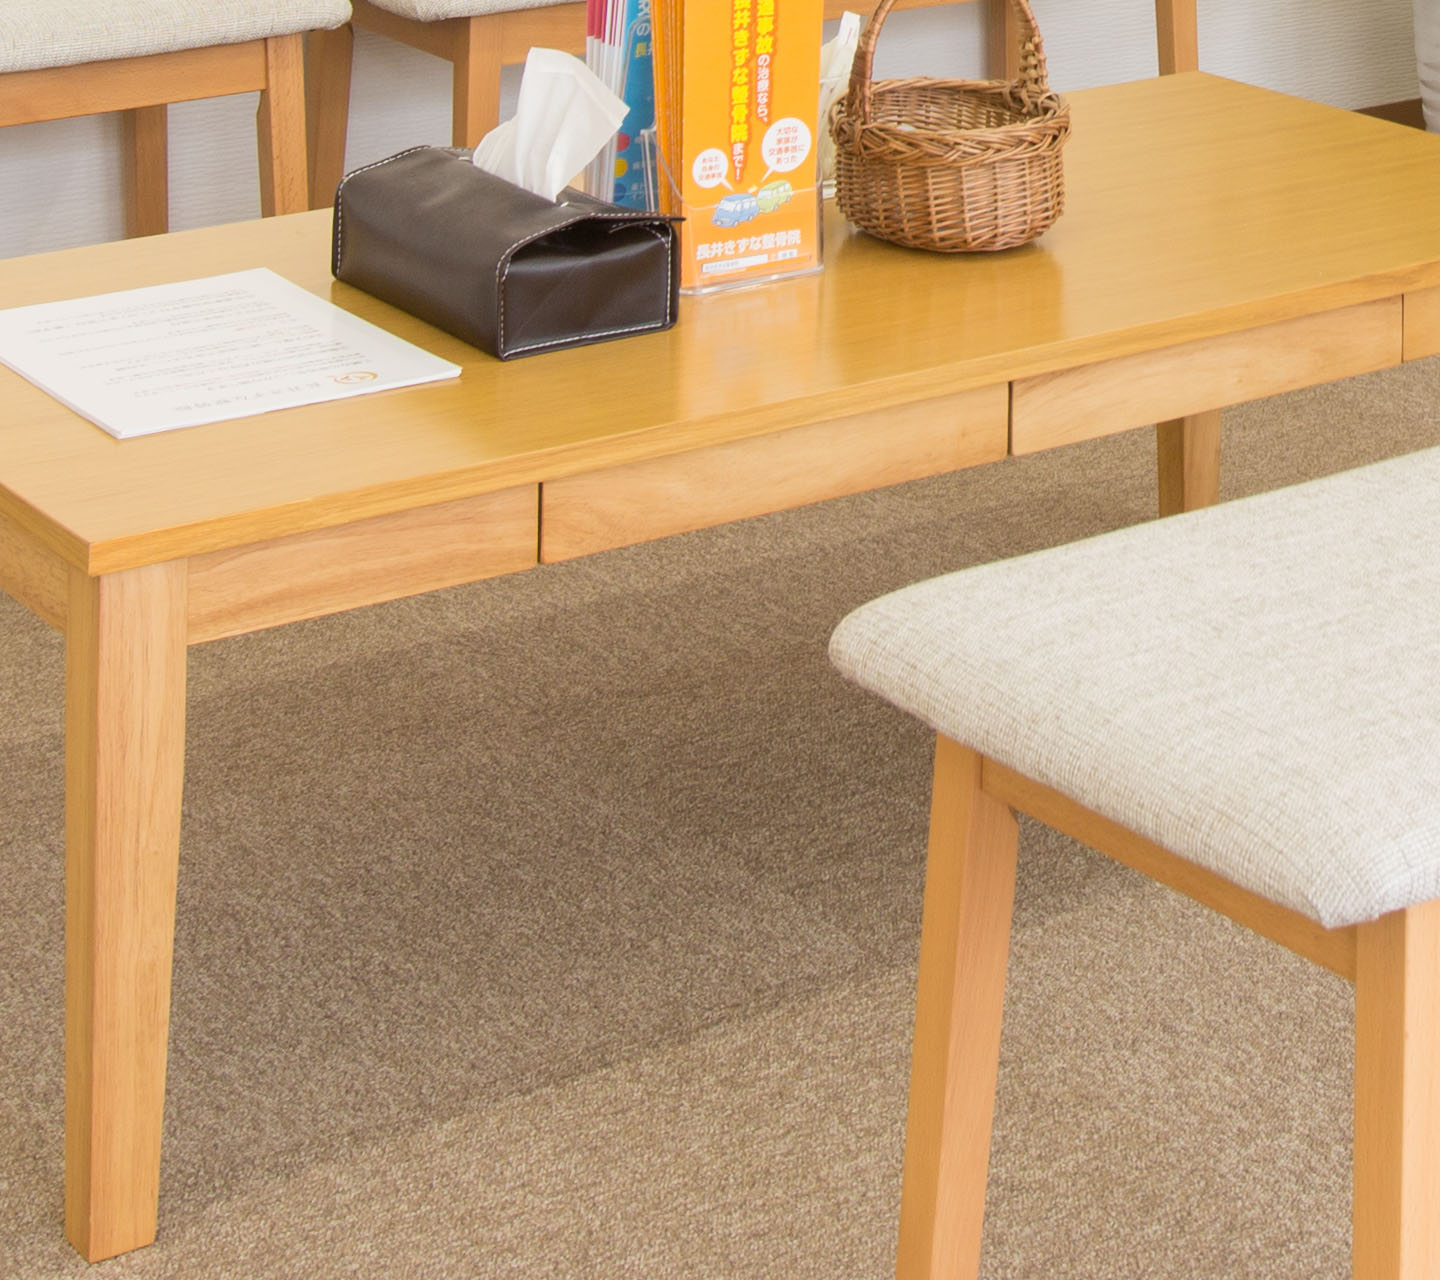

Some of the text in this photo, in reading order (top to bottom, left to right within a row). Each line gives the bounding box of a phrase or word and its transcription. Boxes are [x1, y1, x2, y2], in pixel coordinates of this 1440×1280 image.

[696, 229, 802, 261] 長井きずな整骨院
